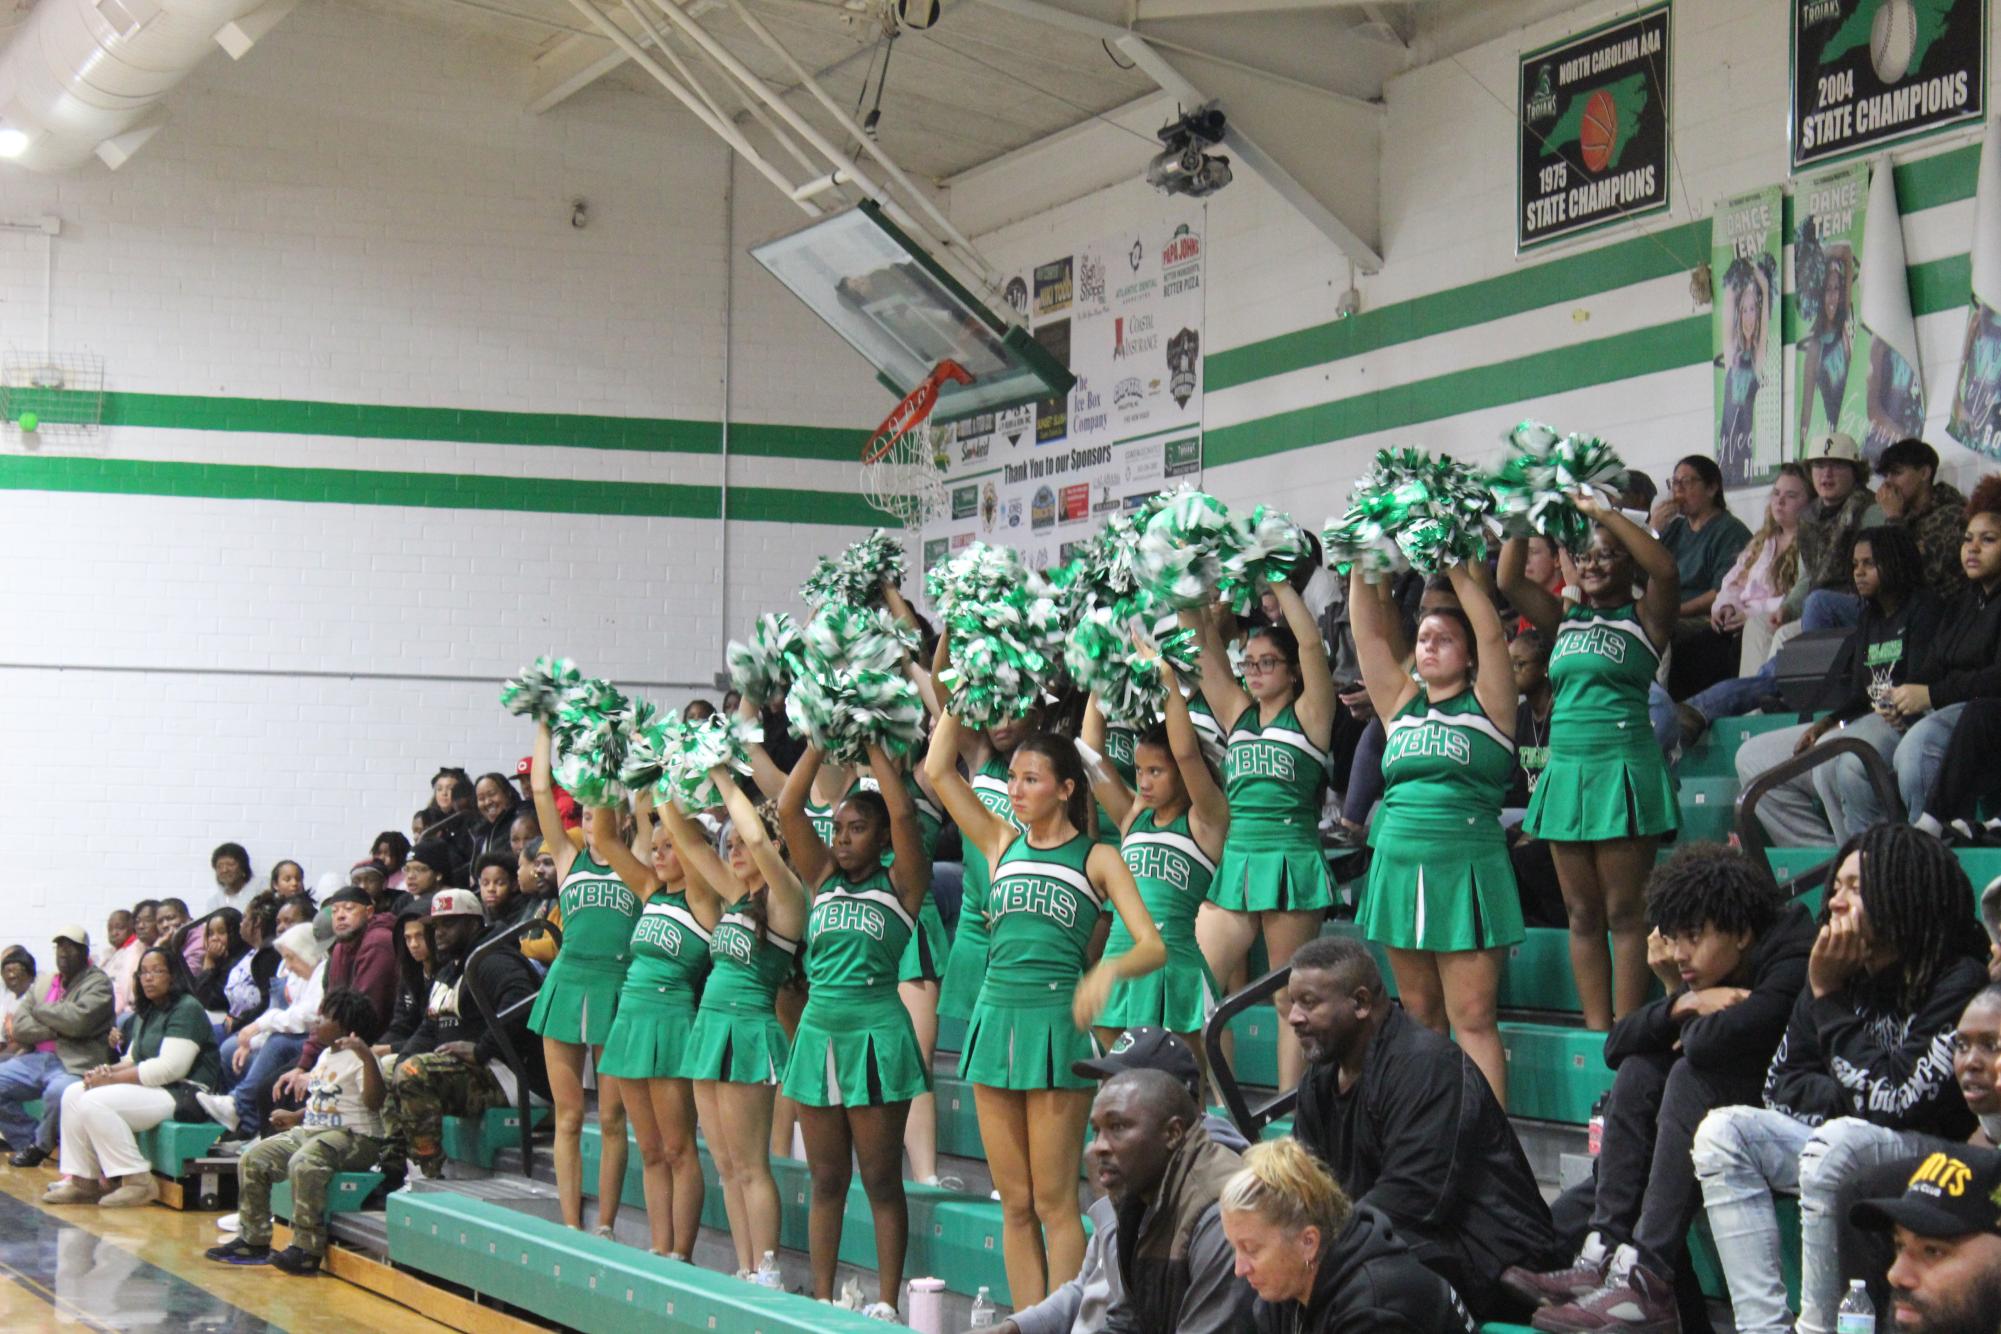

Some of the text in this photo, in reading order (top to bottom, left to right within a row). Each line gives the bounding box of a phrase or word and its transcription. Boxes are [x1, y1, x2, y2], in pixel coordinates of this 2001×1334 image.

[1559, 54, 1591, 86] NORTH
[1592, 36, 1639, 74] CAROLINA
[1818, 69, 1854, 108] 2004
[1802, 70, 1968, 150] STATE CHAMPIONS
[1539, 161, 1567, 194] 1975
[1526, 165, 1656, 232] STATE CHAMPIONS
[1809, 182, 1858, 215] DANCE
[1727, 204, 1771, 236] DANCE
[1813, 209, 1853, 240] TEAM
[1163, 242, 1178, 265] PAPA
[1074, 374, 1088, 392] The
[1074, 394, 1085, 413] Ice
[1087, 391, 1101, 409] Box
[1073, 412, 1107, 435] Company
[1004, 459, 1028, 485] Thank
[1029, 456, 1044, 480] You
[1045, 456, 1054, 476] to
[1055, 453, 1070, 473] our
[1070, 444, 1112, 472] Sponsors
[1549, 627, 1626, 666] WBHS
[1105, 731, 1134, 766] HS
[1225, 743, 1296, 785] WBHS
[1386, 723, 1470, 768] WBHS
[1121, 846, 1190, 890] BHS
[565, 883, 634, 917] WBHS
[989, 879, 1078, 928] WBHS
[630, 916, 682, 957] BHS
[810, 900, 885, 942] WBHS
